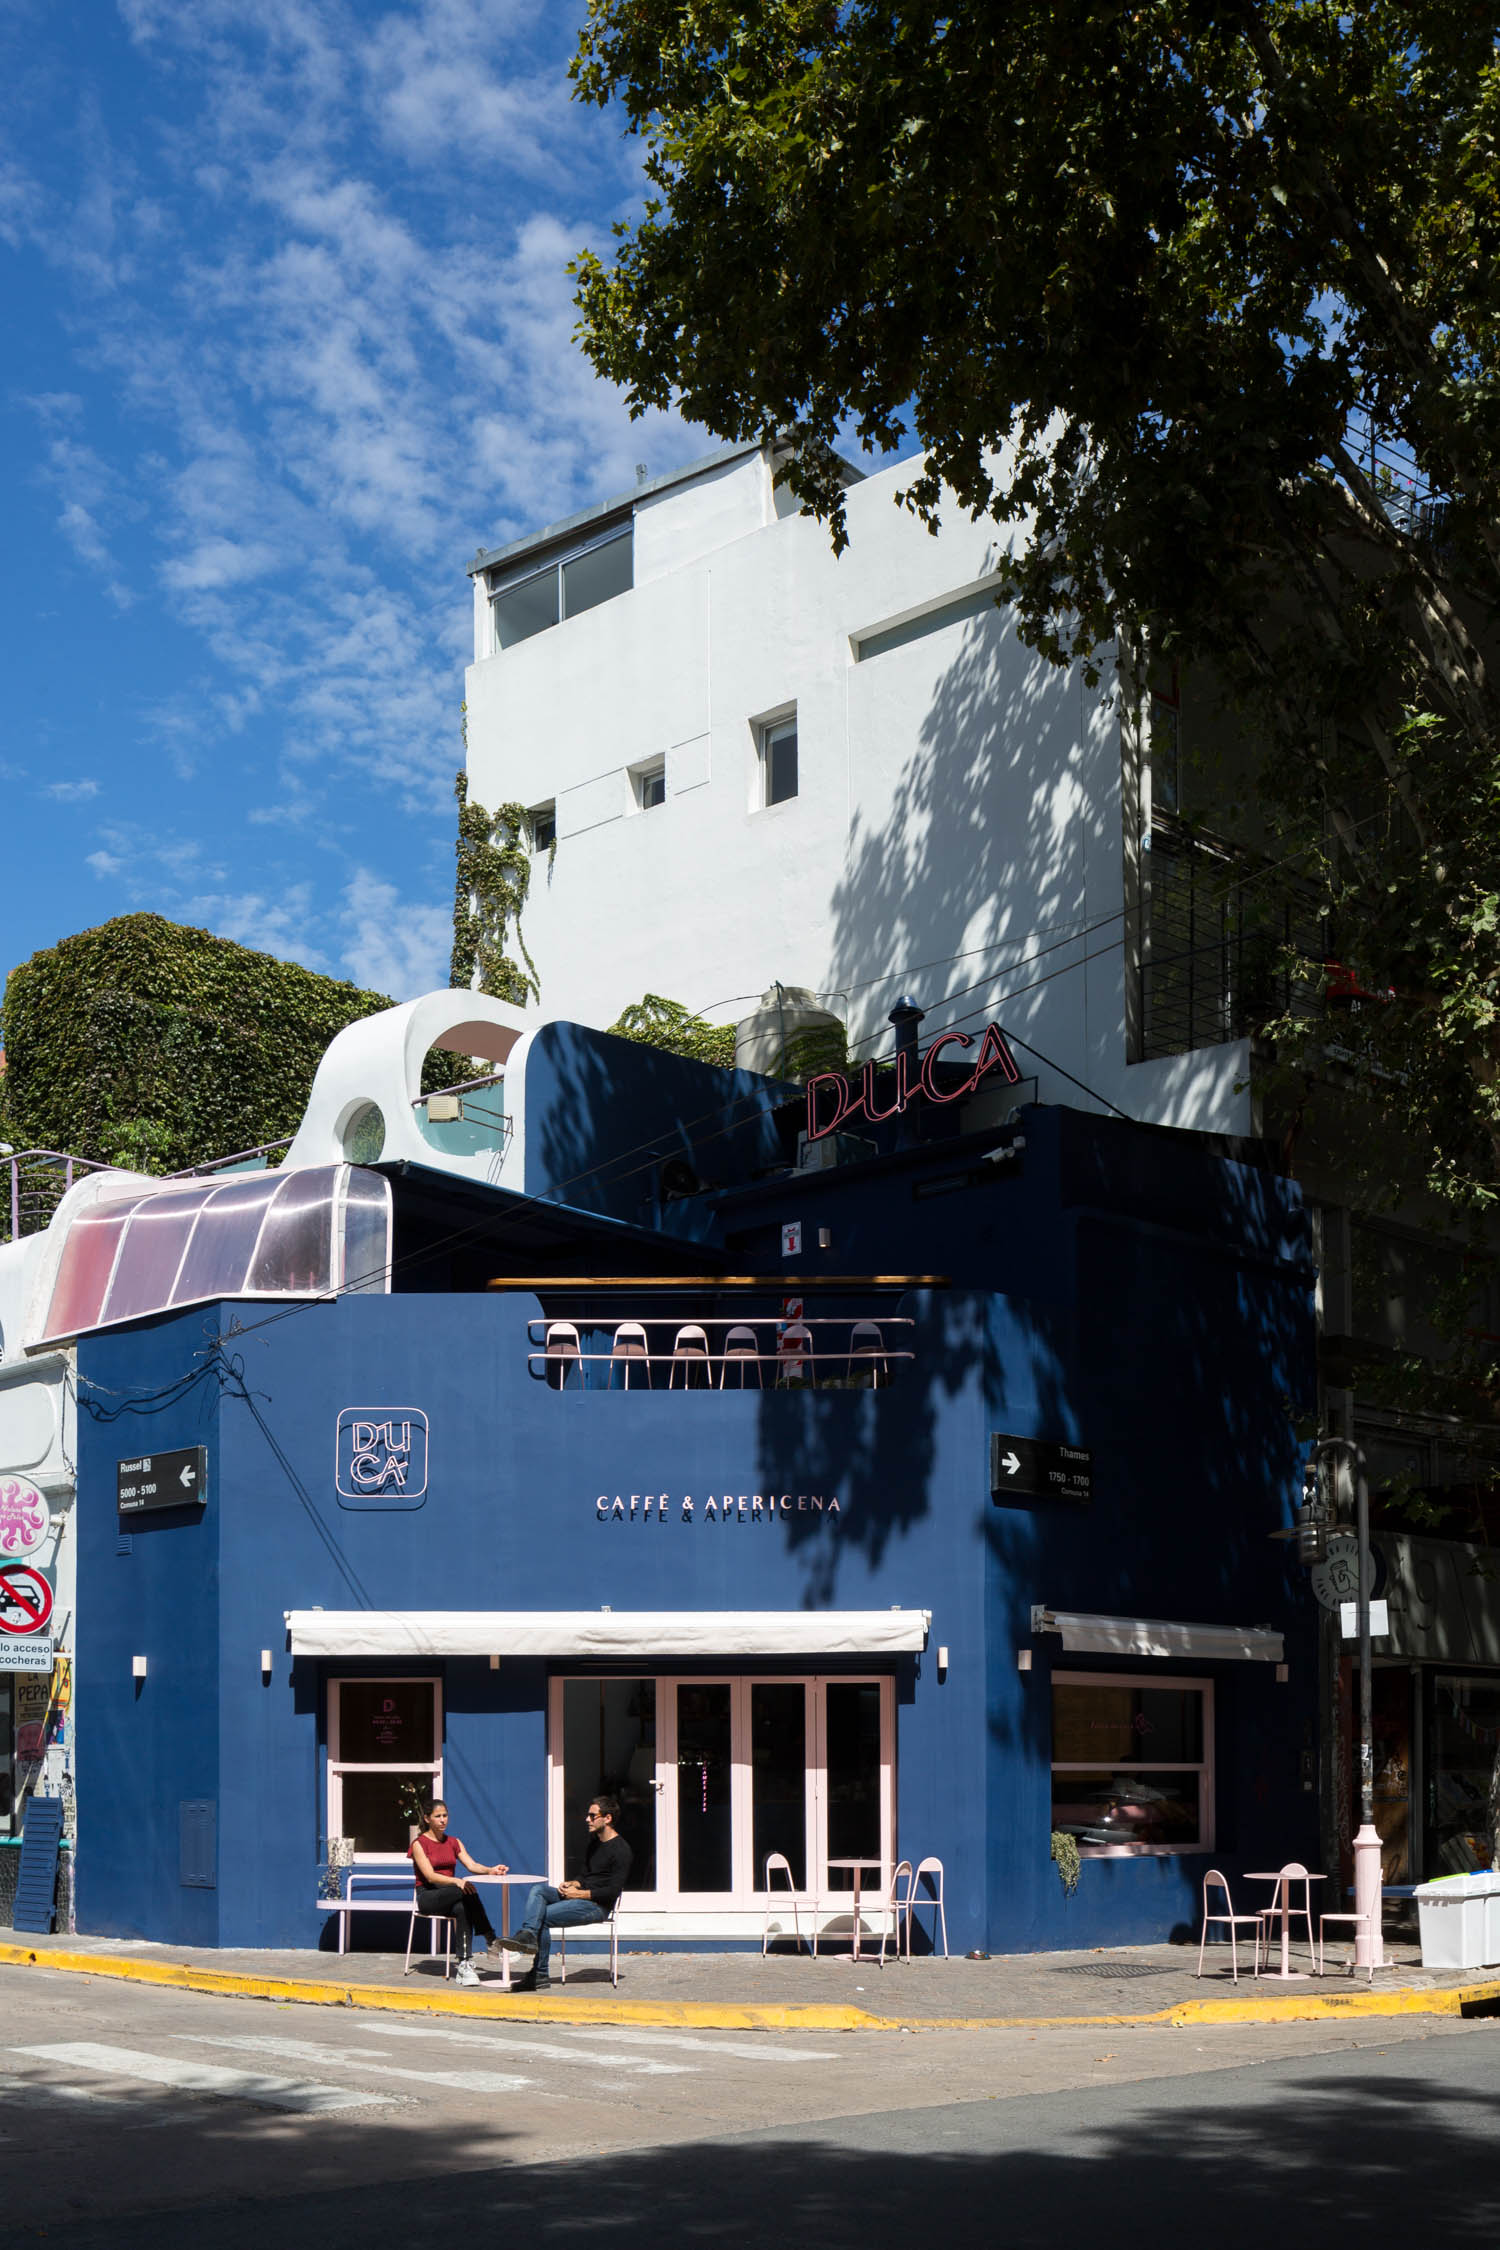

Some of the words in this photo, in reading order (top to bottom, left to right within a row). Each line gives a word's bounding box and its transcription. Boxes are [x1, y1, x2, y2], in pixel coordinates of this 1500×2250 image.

[807, 1022, 1019, 1140] DUCA
[1059, 1446, 1090, 1461] Thames
[120, 1460, 142, 1473] Russel
[1048, 1471, 1066, 1483] 1750
[1072, 1475, 1090, 1487] 1700
[120, 1487, 136, 1499] 5000
[141, 1483, 157, 1495] 5100
[682, 1495, 694, 1510] &
[704, 1495, 841, 1511] APERICENA
[13, 1645, 50, 1654] acceso
[0, 1656, 47, 1666] cocheras
[18, 1684, 48, 1702] PEPA
